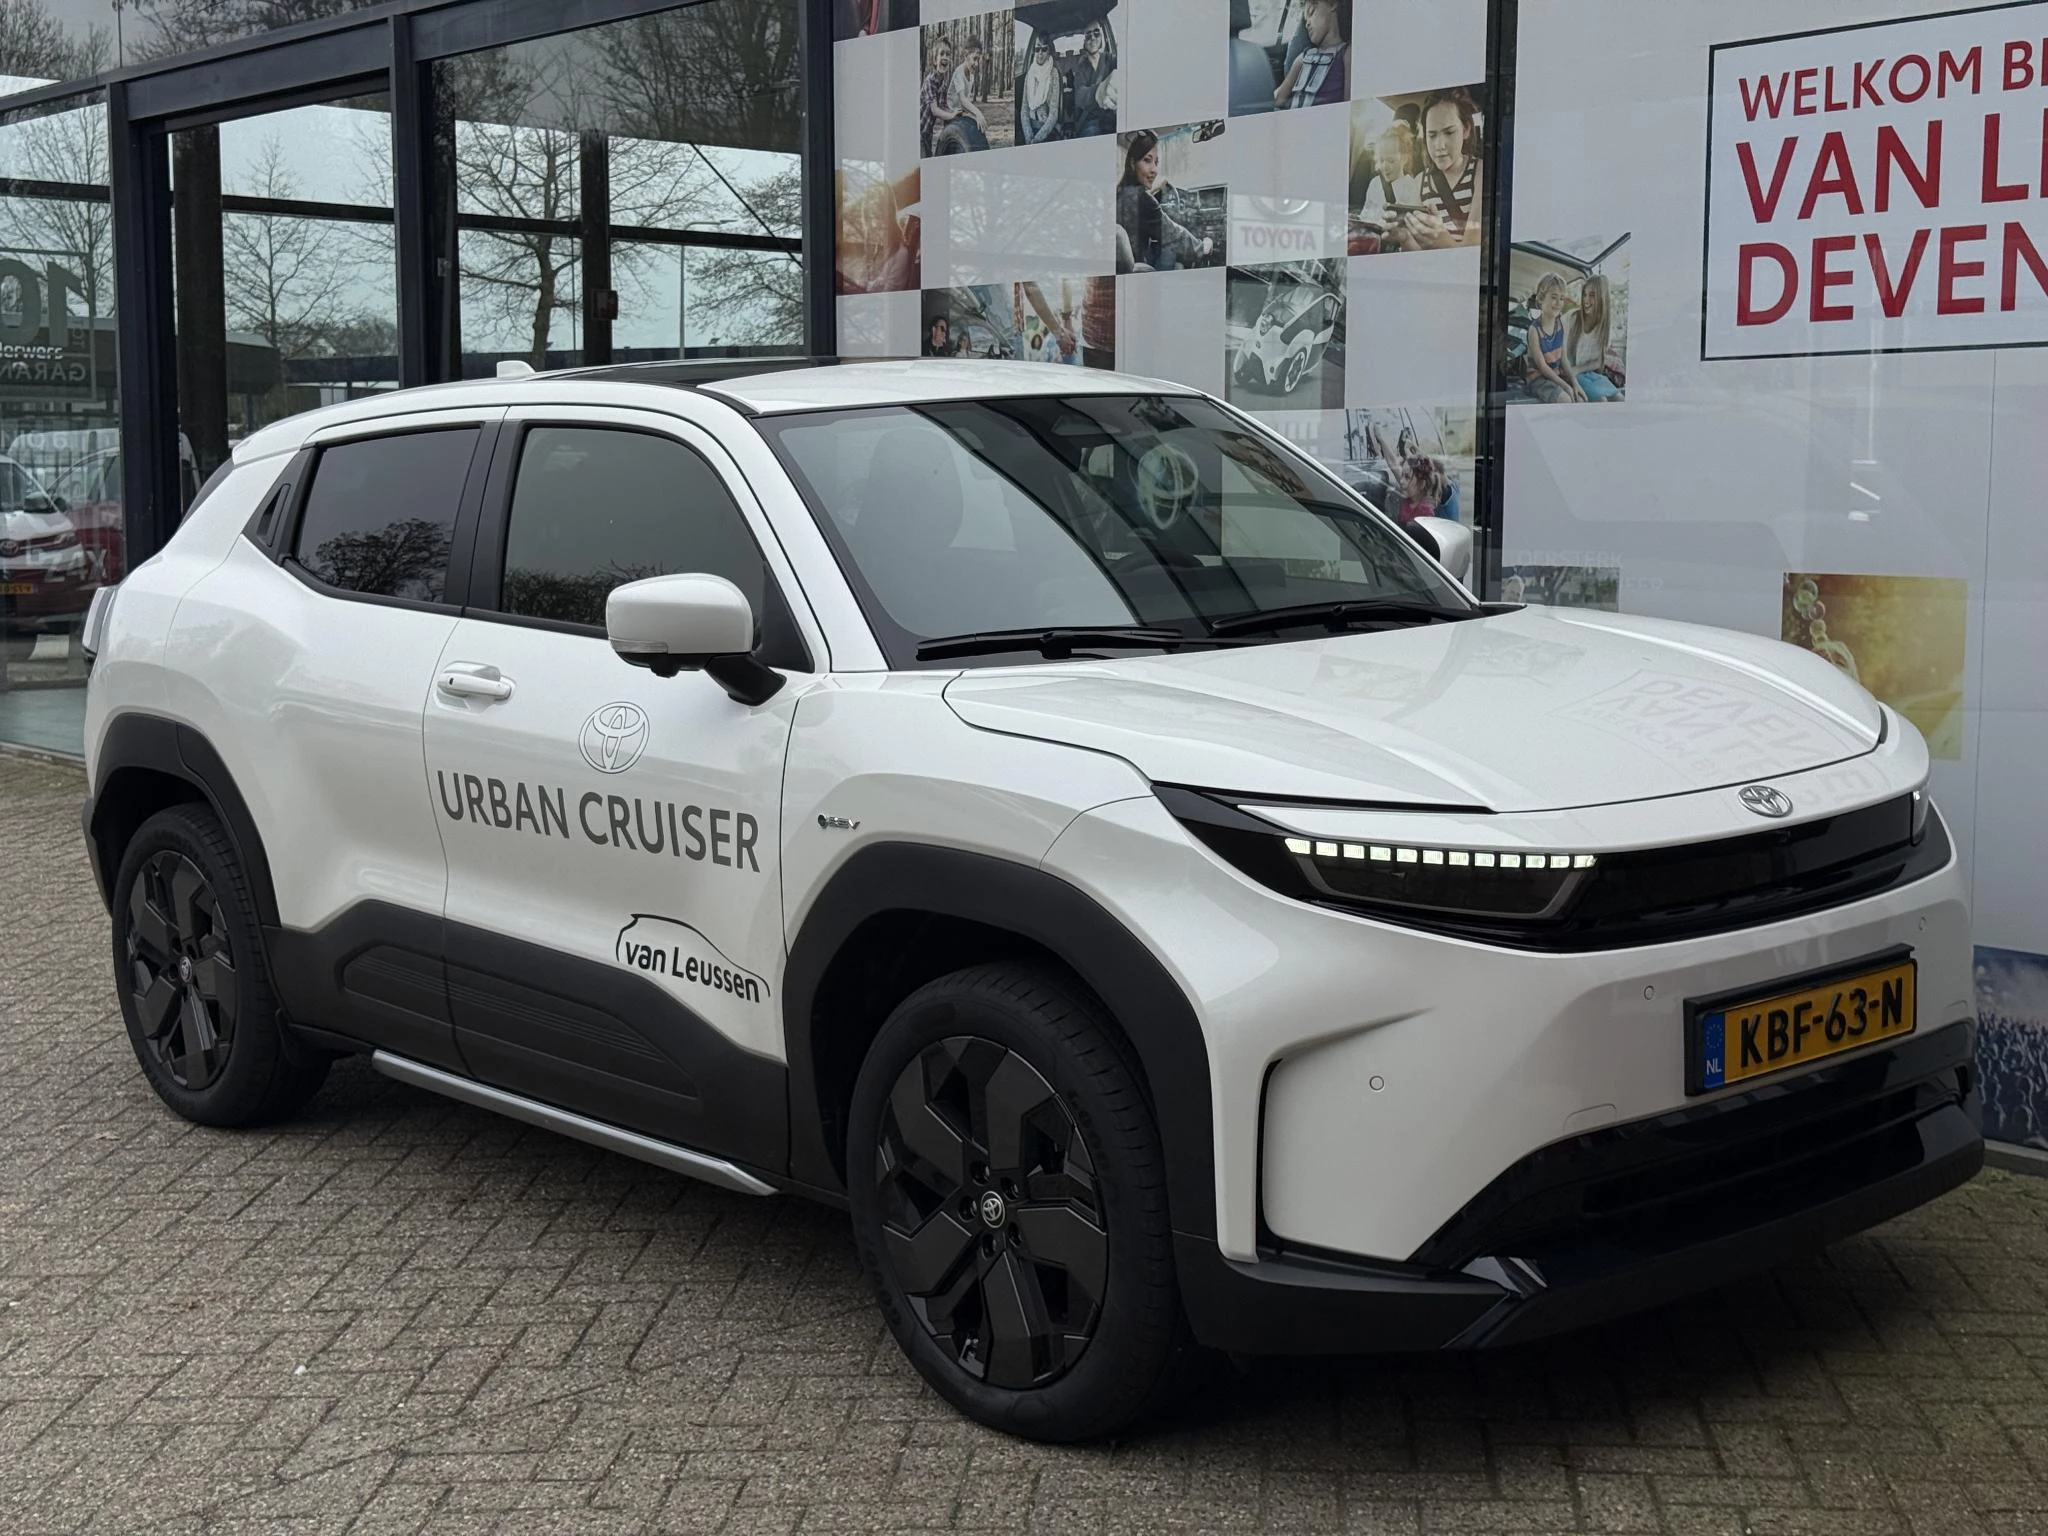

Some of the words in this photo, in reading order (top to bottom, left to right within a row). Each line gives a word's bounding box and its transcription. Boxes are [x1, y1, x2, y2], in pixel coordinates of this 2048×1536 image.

[1738, 46, 1982, 122] WELKOM
[1736, 119, 1943, 224] VAN
[1981, 108, 2048, 204] L
[1239, 225, 1320, 250] TOYOTA
[1736, 222, 2048, 327] DEVEN
[437, 770, 570, 839] URBAN
[578, 791, 760, 873] CRUISER
[625, 941, 667, 974] van
[671, 946, 760, 1003] Leussen
[1740, 976, 1903, 1068] KBF-63-N
[1706, 1058, 1722, 1076] NL
